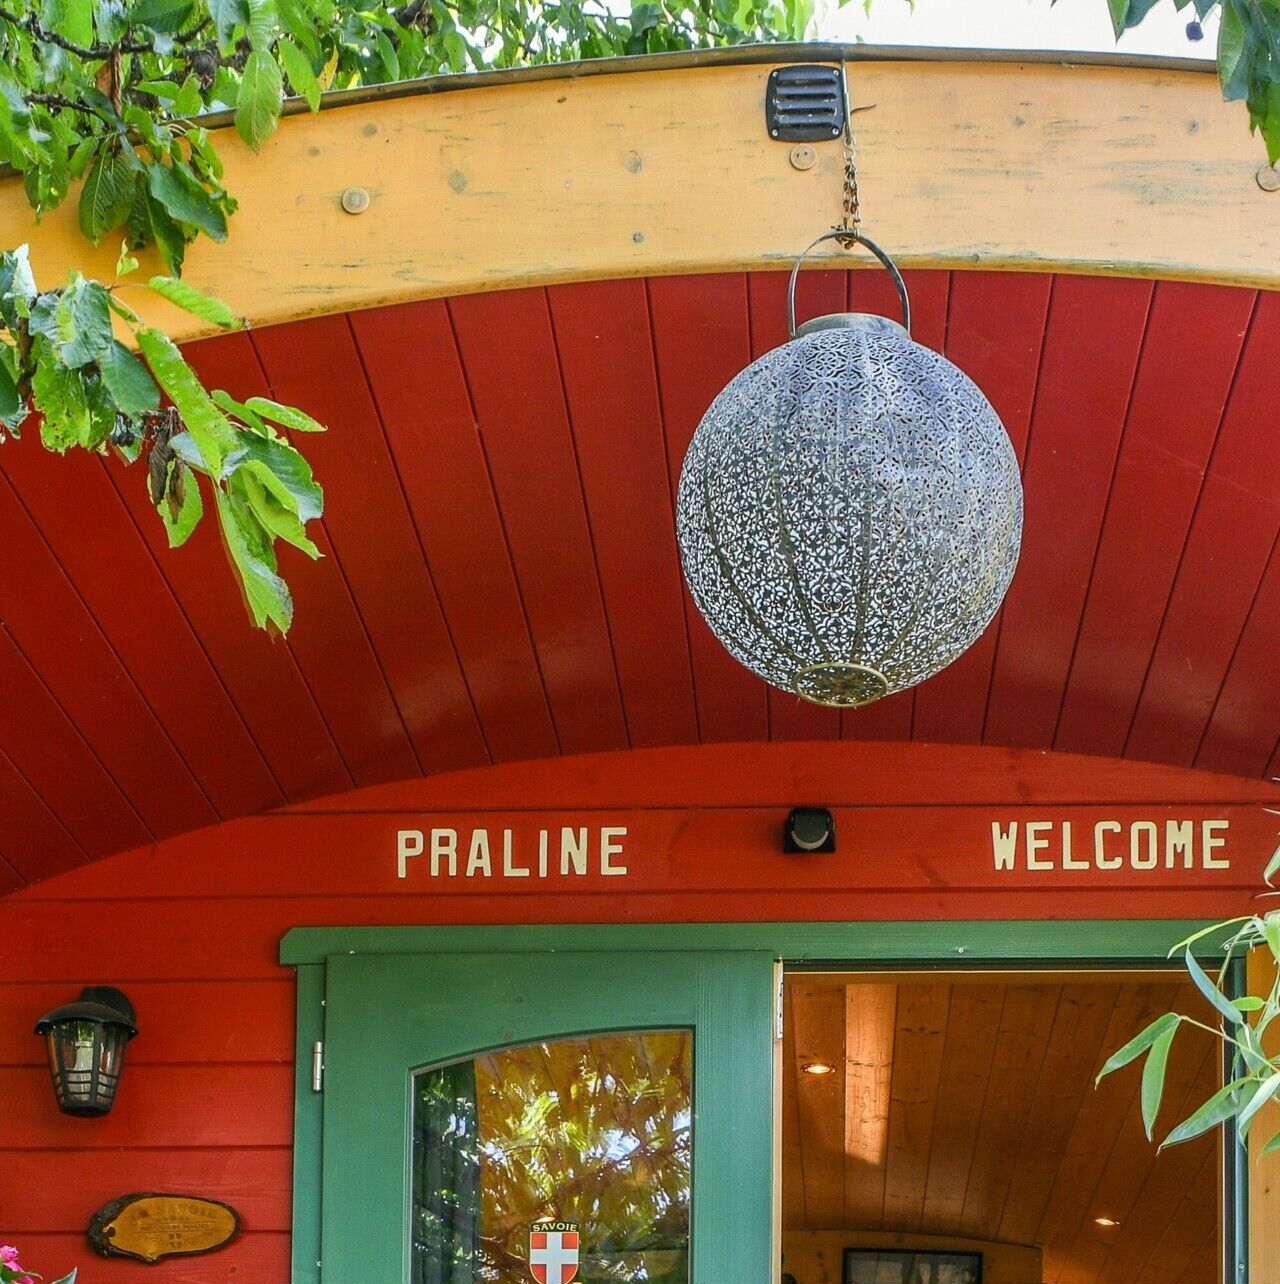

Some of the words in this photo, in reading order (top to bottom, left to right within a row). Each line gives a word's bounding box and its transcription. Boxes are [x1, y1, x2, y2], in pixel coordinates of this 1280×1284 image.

[396, 827, 628, 878] PRALINE
[991, 820, 1231, 871] WELCOME
[532, 1222, 578, 1232] SAVOIE
